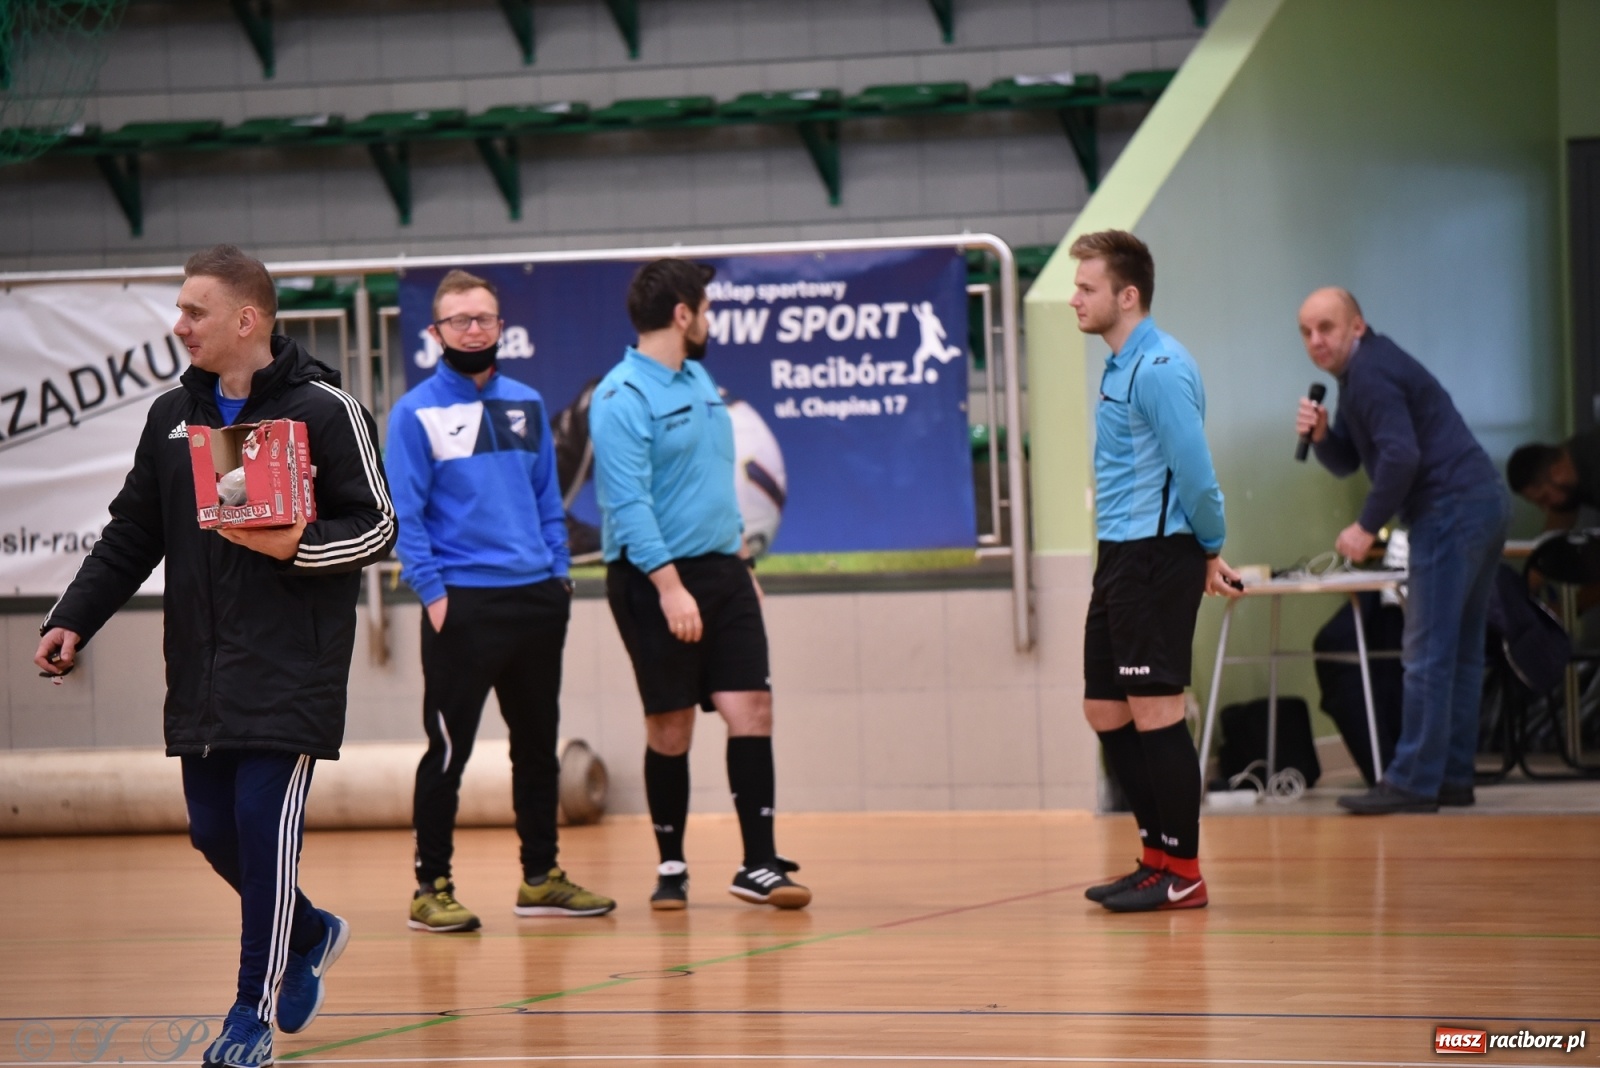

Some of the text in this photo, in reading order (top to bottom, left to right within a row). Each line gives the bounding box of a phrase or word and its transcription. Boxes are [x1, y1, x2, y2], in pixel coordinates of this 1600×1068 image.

[757, 281, 847, 303] sportowy
[776, 302, 908, 343] SPORT
[0, 334, 181, 442] ZĄDKU
[771, 353, 908, 389] Racibórz
[774, 395, 907, 420] ul. Chopina 17
